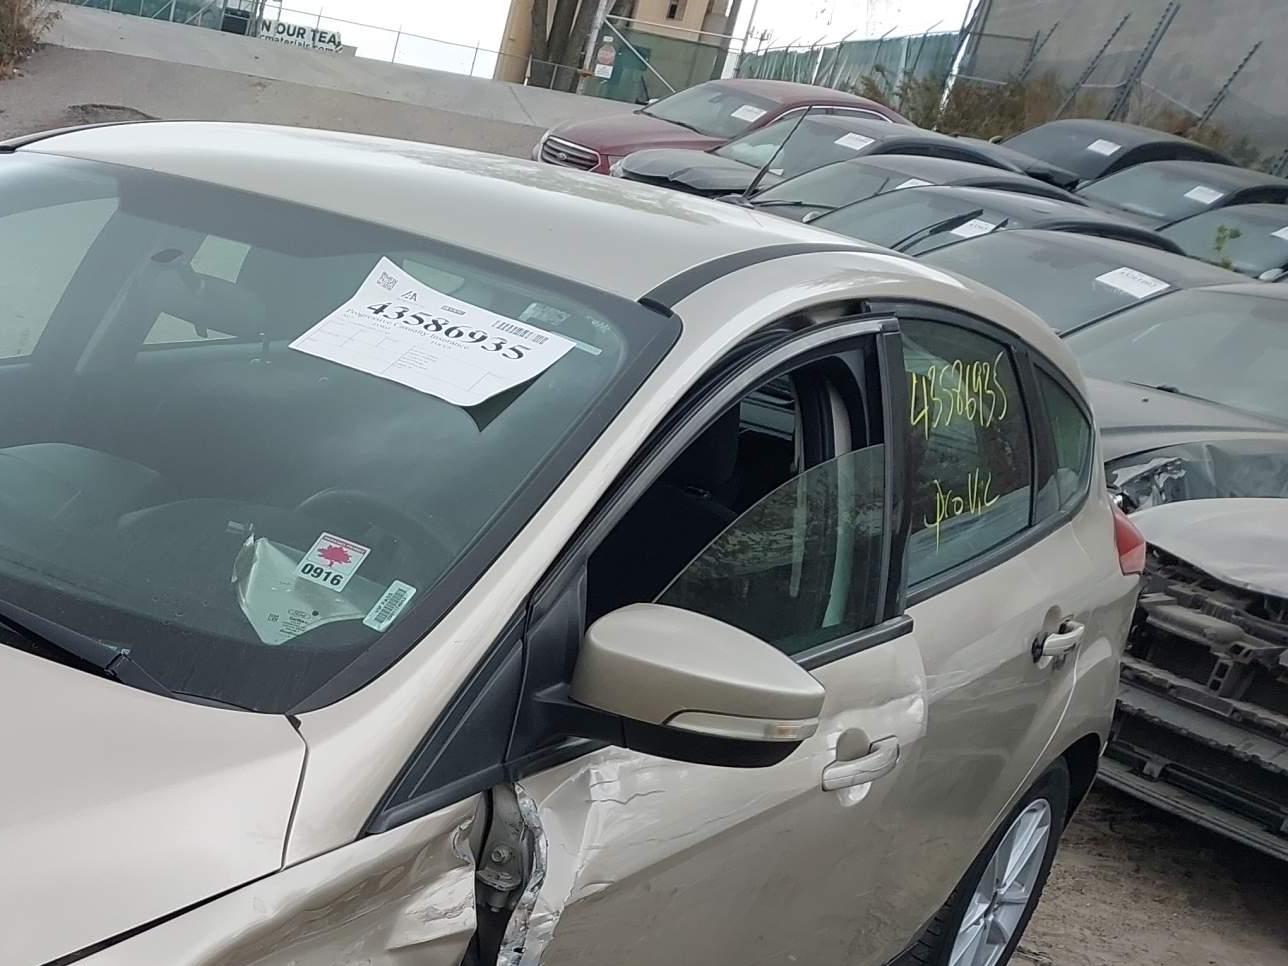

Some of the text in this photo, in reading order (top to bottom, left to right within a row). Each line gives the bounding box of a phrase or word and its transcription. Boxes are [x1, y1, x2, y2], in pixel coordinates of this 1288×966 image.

[276, 22, 306, 39] OUR
[367, 302, 531, 361] 43586935
[910, 351, 1008, 440] 43586935
[301, 563, 343, 585] 0916
